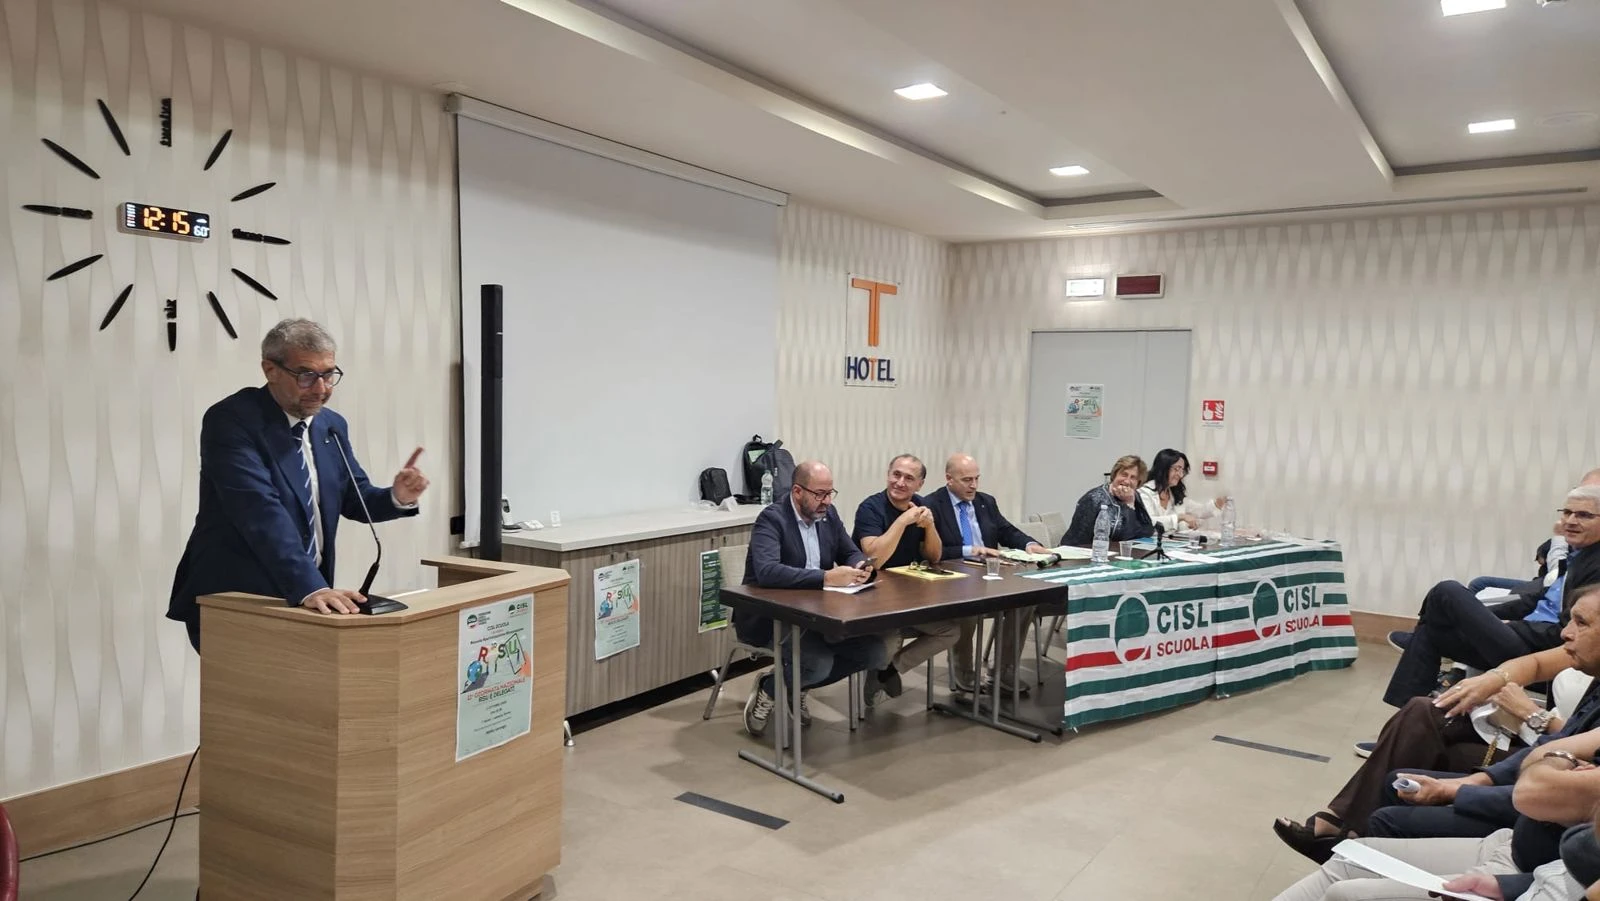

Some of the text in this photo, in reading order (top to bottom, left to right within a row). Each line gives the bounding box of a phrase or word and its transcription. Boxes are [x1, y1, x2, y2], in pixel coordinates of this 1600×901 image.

[143, 206, 190, 235] 12:15
[851, 278, 897, 347] T
[847, 356, 895, 382] HOTEL
[1283, 585, 1320, 613] CISL
[1157, 602, 1208, 634] CISL
[1157, 636, 1209, 657] SCUOLA
